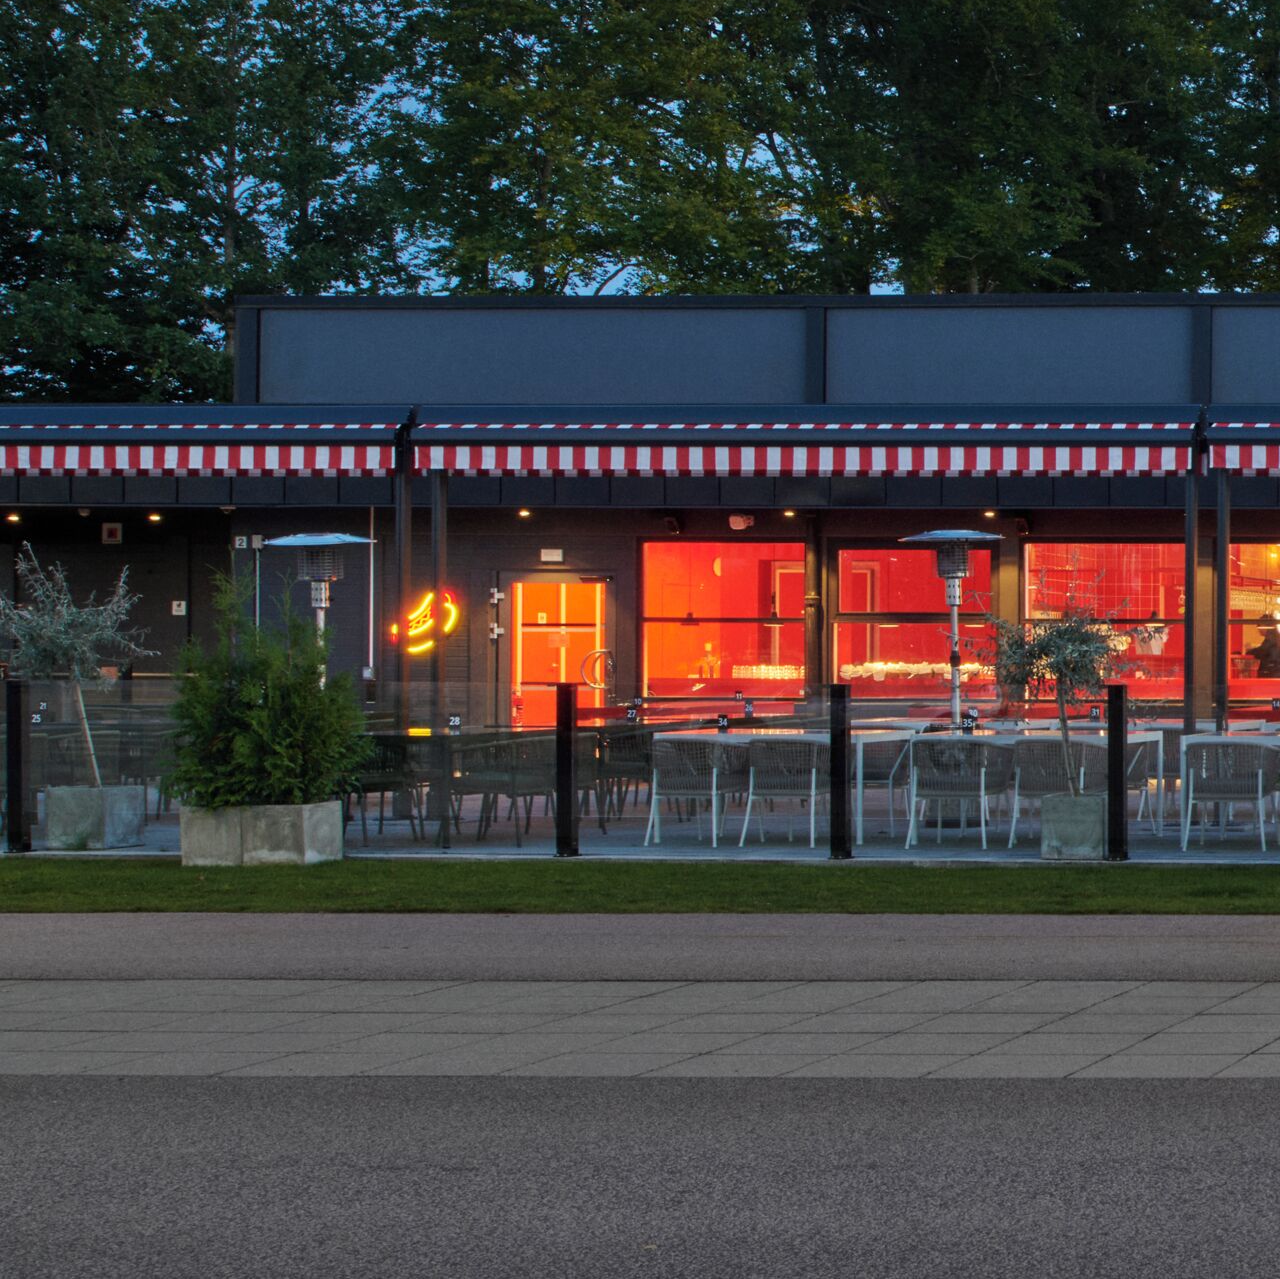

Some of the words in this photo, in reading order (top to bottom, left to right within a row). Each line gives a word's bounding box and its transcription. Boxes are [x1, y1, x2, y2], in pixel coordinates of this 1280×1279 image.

[238, 538, 245, 547] 2
[628, 709, 637, 718] 27
[1091, 708, 1099, 717] 31
[32, 714, 41, 723] 25
[450, 716, 460, 726] 28
[718, 718, 728, 726] 34
[962, 719, 973, 728] 35
